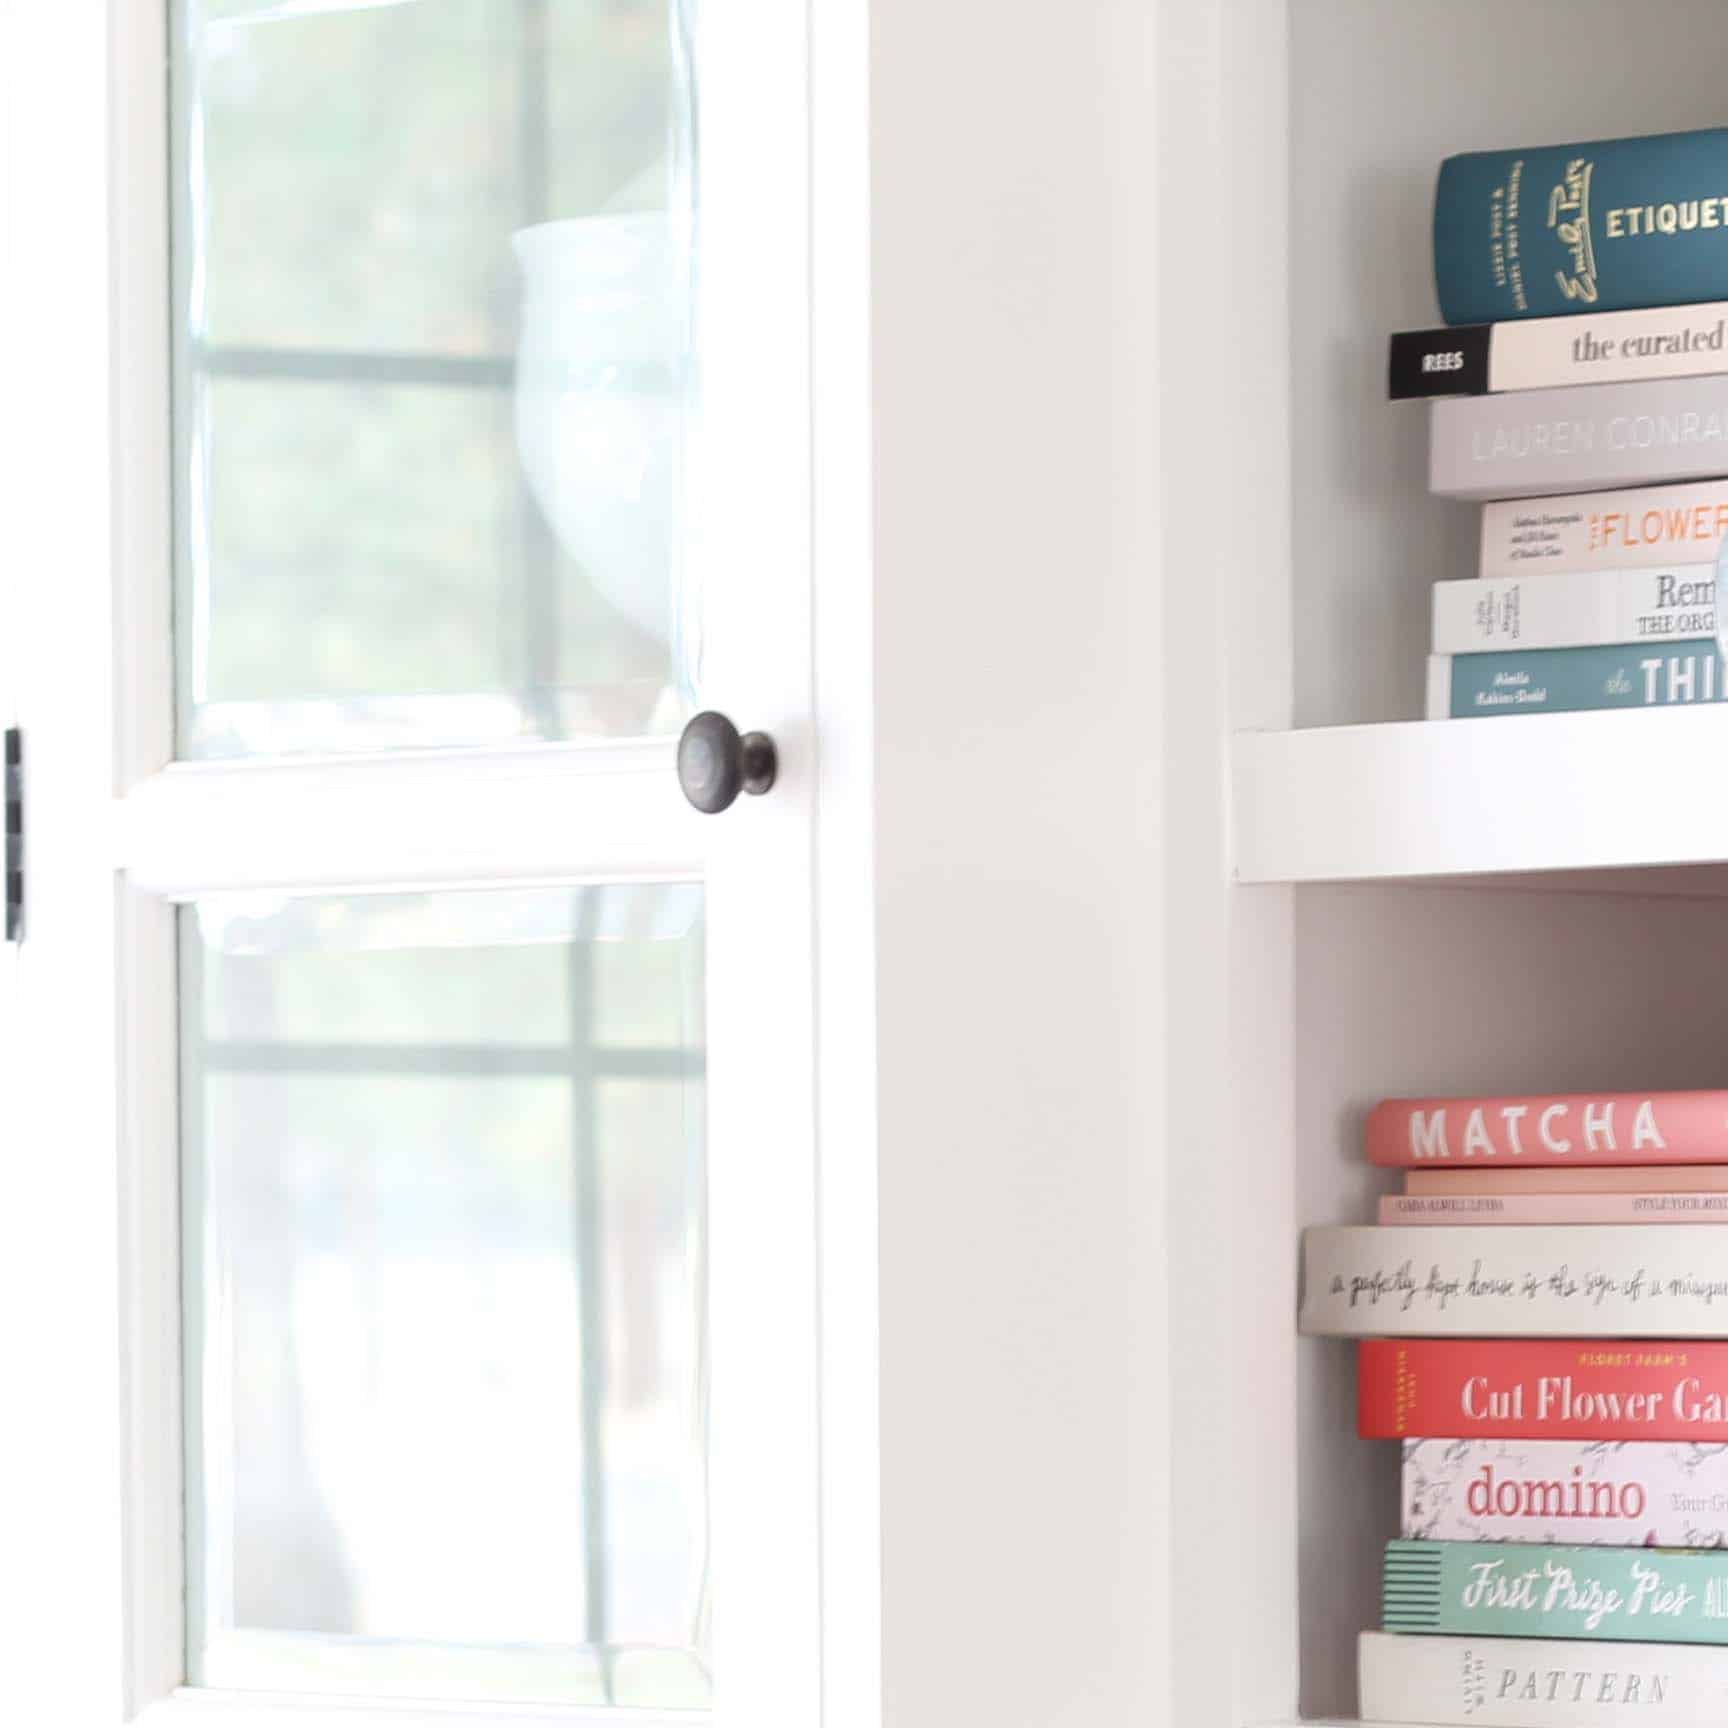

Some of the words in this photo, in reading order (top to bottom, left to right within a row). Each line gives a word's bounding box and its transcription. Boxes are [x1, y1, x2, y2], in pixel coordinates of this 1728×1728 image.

[1421, 350, 1464, 373] REES
[1572, 331, 1613, 364] the
[1621, 322, 1725, 359] curated
[1472, 417, 1595, 462] LAUREN
[1408, 1101, 1667, 1160] MATCHA
[1349, 1258, 1417, 1312] perfectly
[1425, 1264, 1462, 1311] kept
[1465, 1257, 1516, 1298] house
[1547, 1264, 1579, 1298] the
[1462, 1374, 1530, 1422] Cut
[1536, 1375, 1664, 1424] Flower
[1467, 1463, 1647, 1519] domino
[1462, 1559, 1542, 1612] First
[1542, 1560, 1623, 1631] Prize
[1628, 1560, 1697, 1616] Pies
[1496, 1668, 1670, 1706] PATTERN
